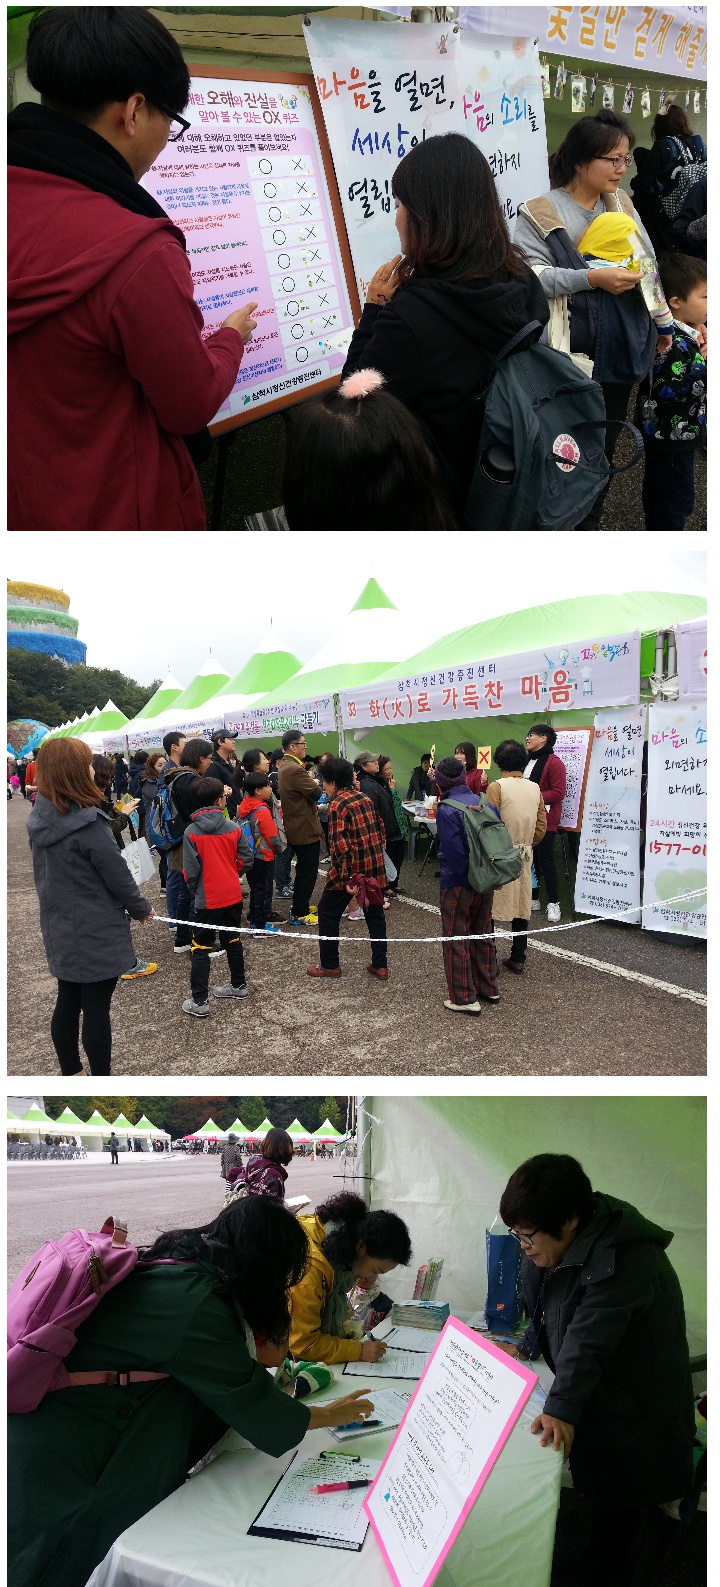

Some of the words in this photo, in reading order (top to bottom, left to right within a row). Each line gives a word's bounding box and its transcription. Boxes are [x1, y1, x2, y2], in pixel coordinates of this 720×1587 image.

[675, 20, 707, 69] 해줄
[207, 91, 244, 107] 오해와
[243, 92, 278, 109] 진실을
[316, 67, 386, 113] 마음을
[395, 70, 455, 111] 열면,
[199, 111, 219, 123] 알아
[221, 111, 230, 123] 볼
[232, 111, 242, 123] 수
[243, 111, 262, 124] 있는
[263, 110, 283, 124] OX
[283, 113, 300, 124] 퀴즈
[501, 92, 540, 133] 소리를
[348, 178, 395, 219] 열립
[252, 369, 322, 401] 삼척시정신건강증진센터
[397, 663, 496, 691] 삼척시정신건강증진센터
[347, 702, 357, 717] 33
[442, 680, 504, 710] 가득찬
[521, 670, 573, 704] 마음
[595, 725, 618, 742] 마음을
[652, 728, 688, 748] 마음의
[650, 820, 675, 829] 24시간
